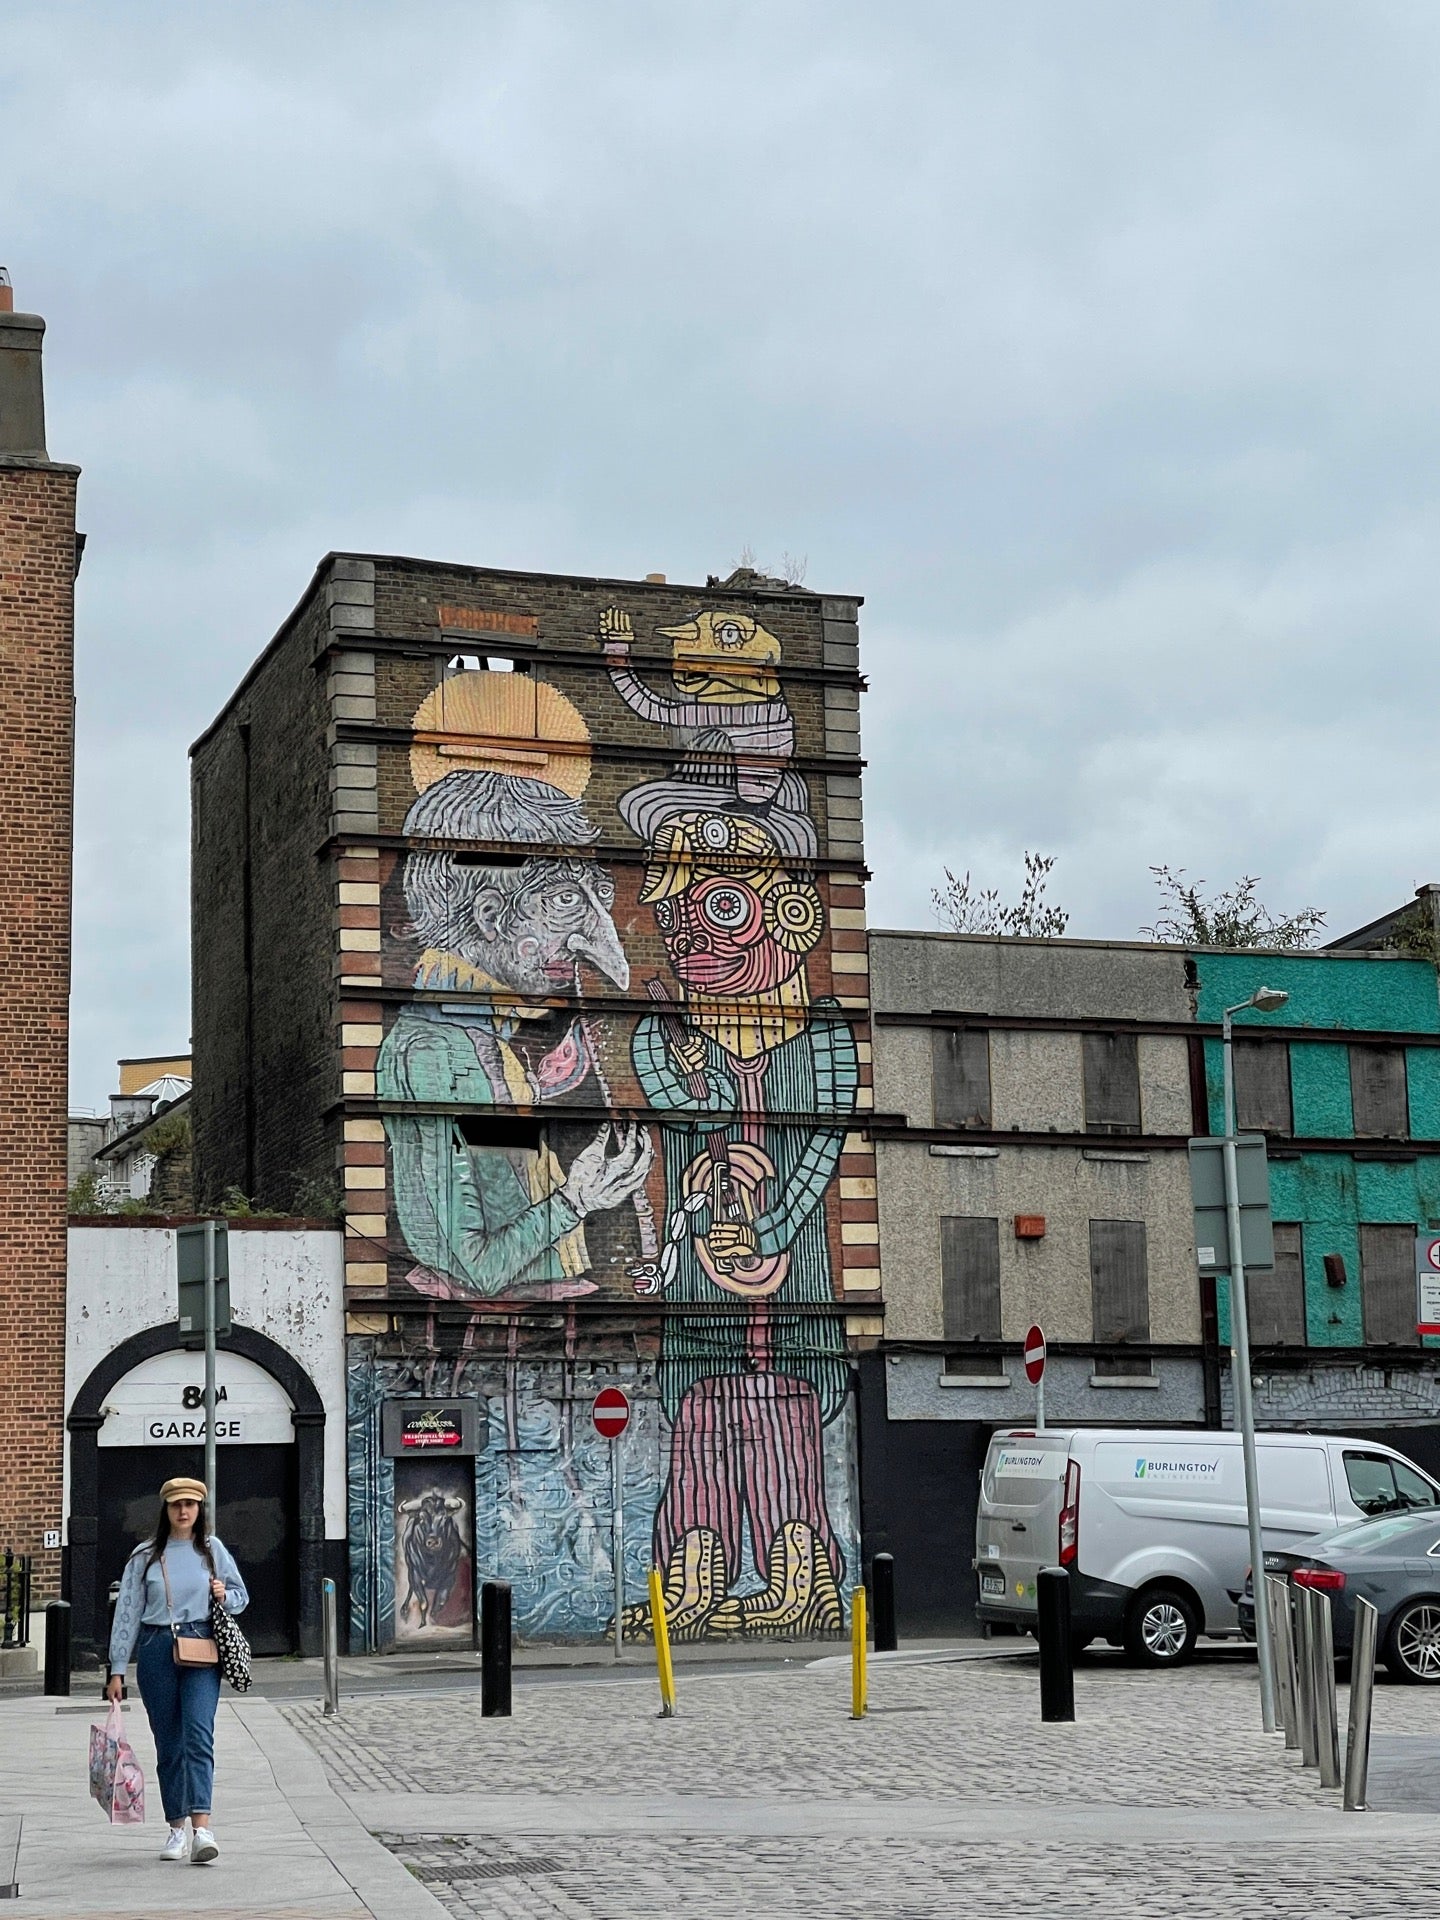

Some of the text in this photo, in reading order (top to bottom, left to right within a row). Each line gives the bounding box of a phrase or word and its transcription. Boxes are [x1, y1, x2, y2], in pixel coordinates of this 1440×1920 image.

[149, 1421, 241, 1439] GARAGE
[1004, 1454, 1045, 1466] BURLINGTON
[1148, 1458, 1219, 1473] BURLINGTON
